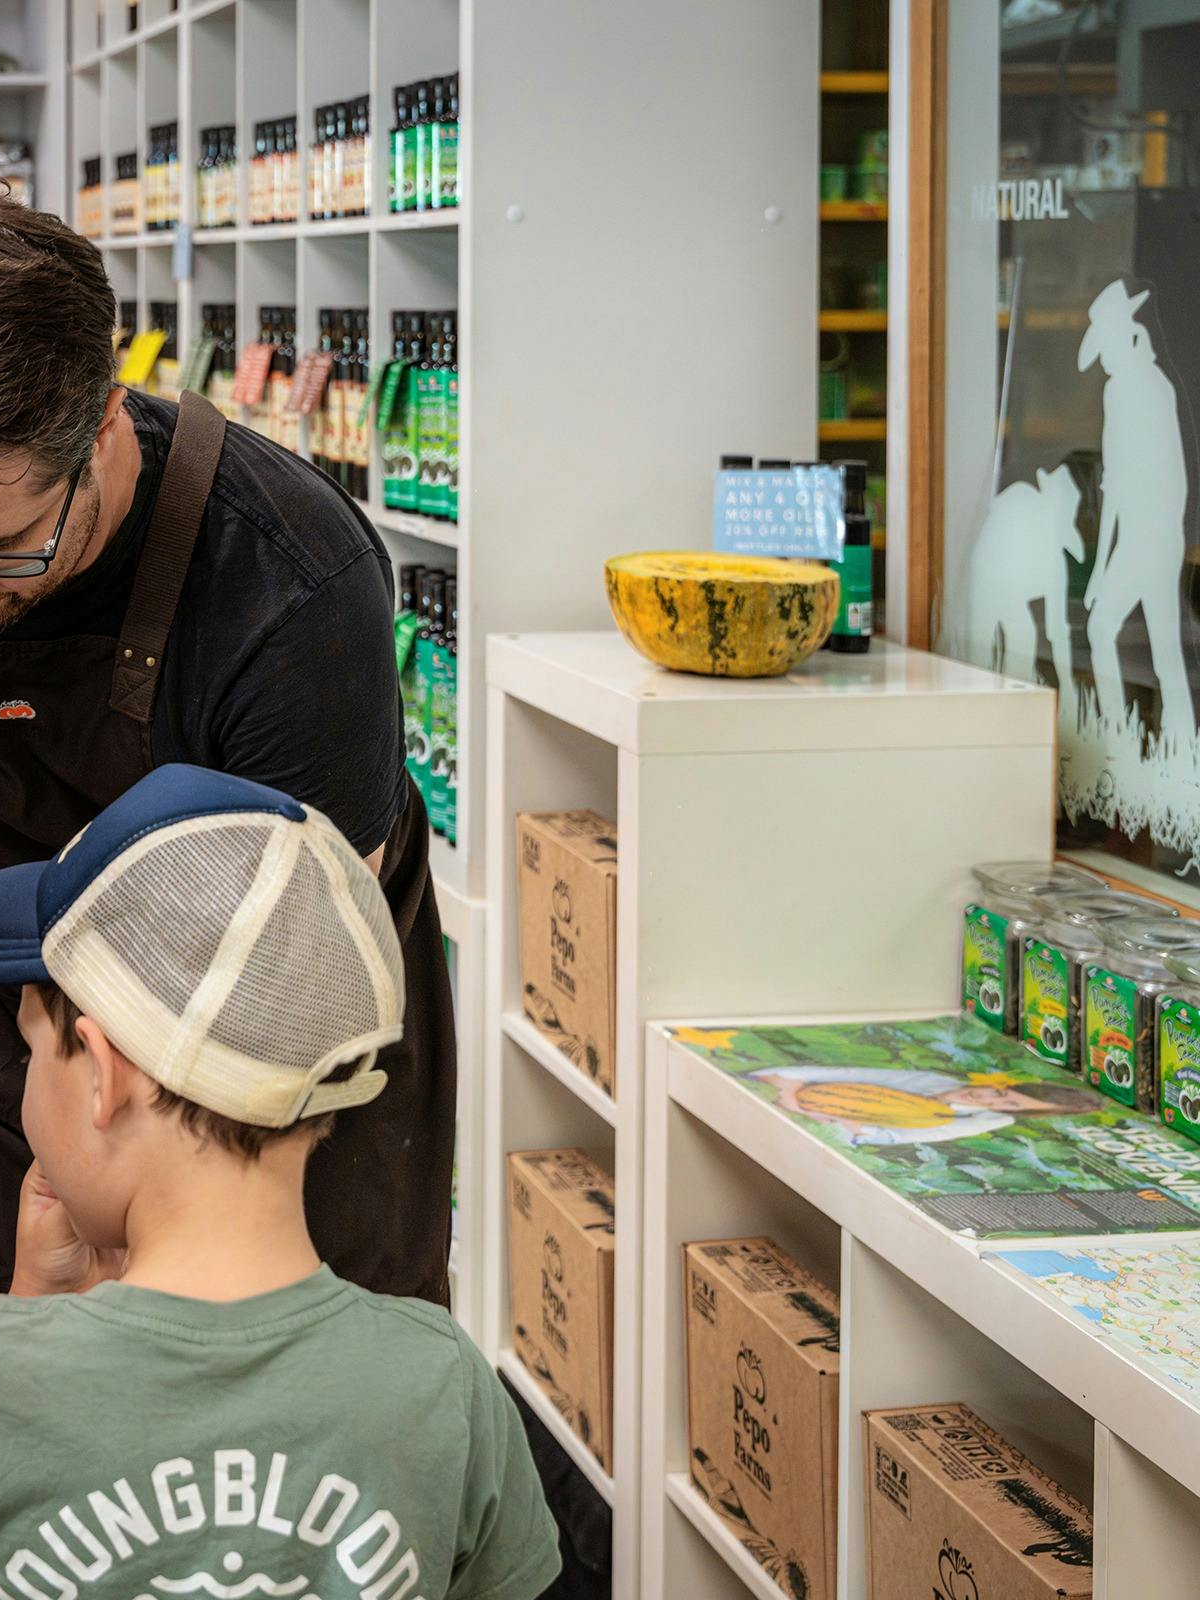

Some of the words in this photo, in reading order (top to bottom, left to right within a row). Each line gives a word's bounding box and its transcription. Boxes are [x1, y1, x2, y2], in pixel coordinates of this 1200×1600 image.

[972, 178, 1069, 221] NATURAL
[725, 490, 766, 505] ANY
[725, 509, 774, 522] MORE
[758, 524, 787, 537] OFF
[732, 1384, 771, 1455] Pepo
[733, 1428, 772, 1493] Farms
